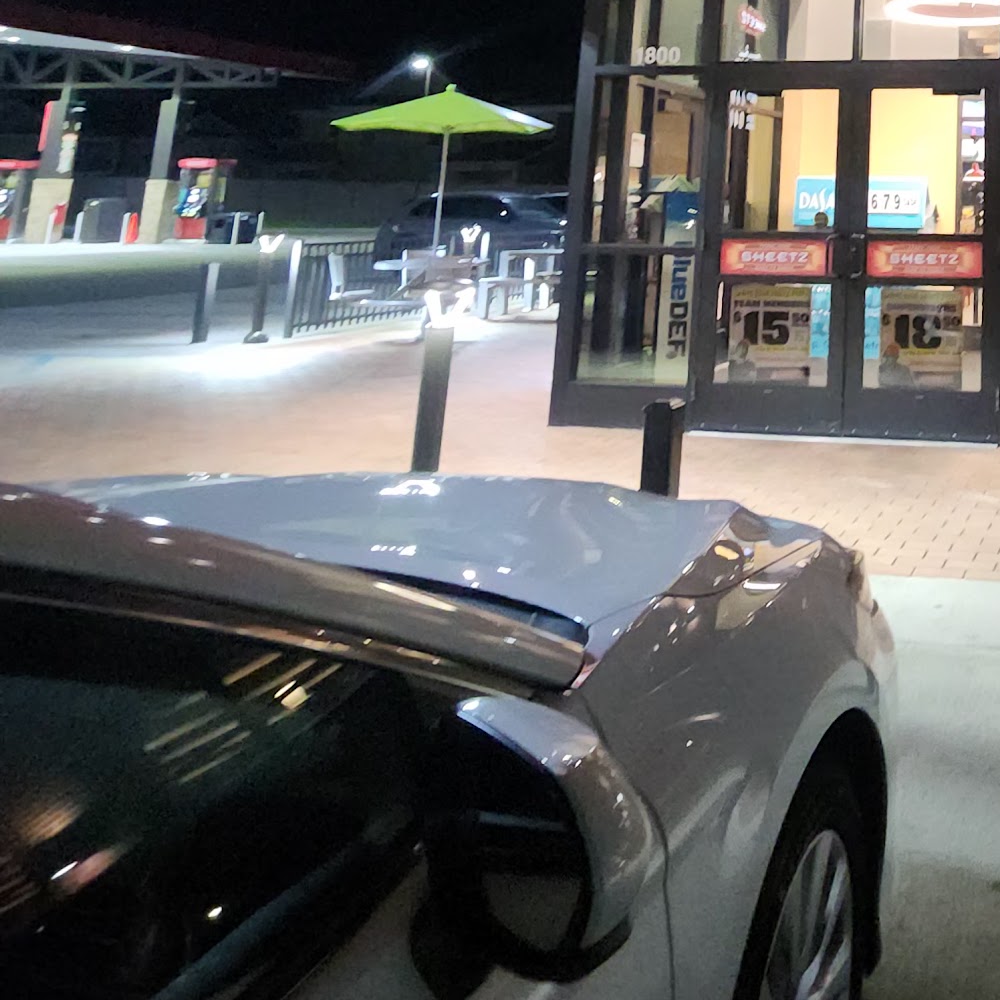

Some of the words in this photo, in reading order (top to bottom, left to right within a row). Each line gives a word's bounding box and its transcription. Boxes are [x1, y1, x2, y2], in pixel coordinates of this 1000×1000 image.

[637, 46, 681, 65] 1800
[798, 187, 835, 212] DASA
[667, 241, 693, 357] lueDEF
